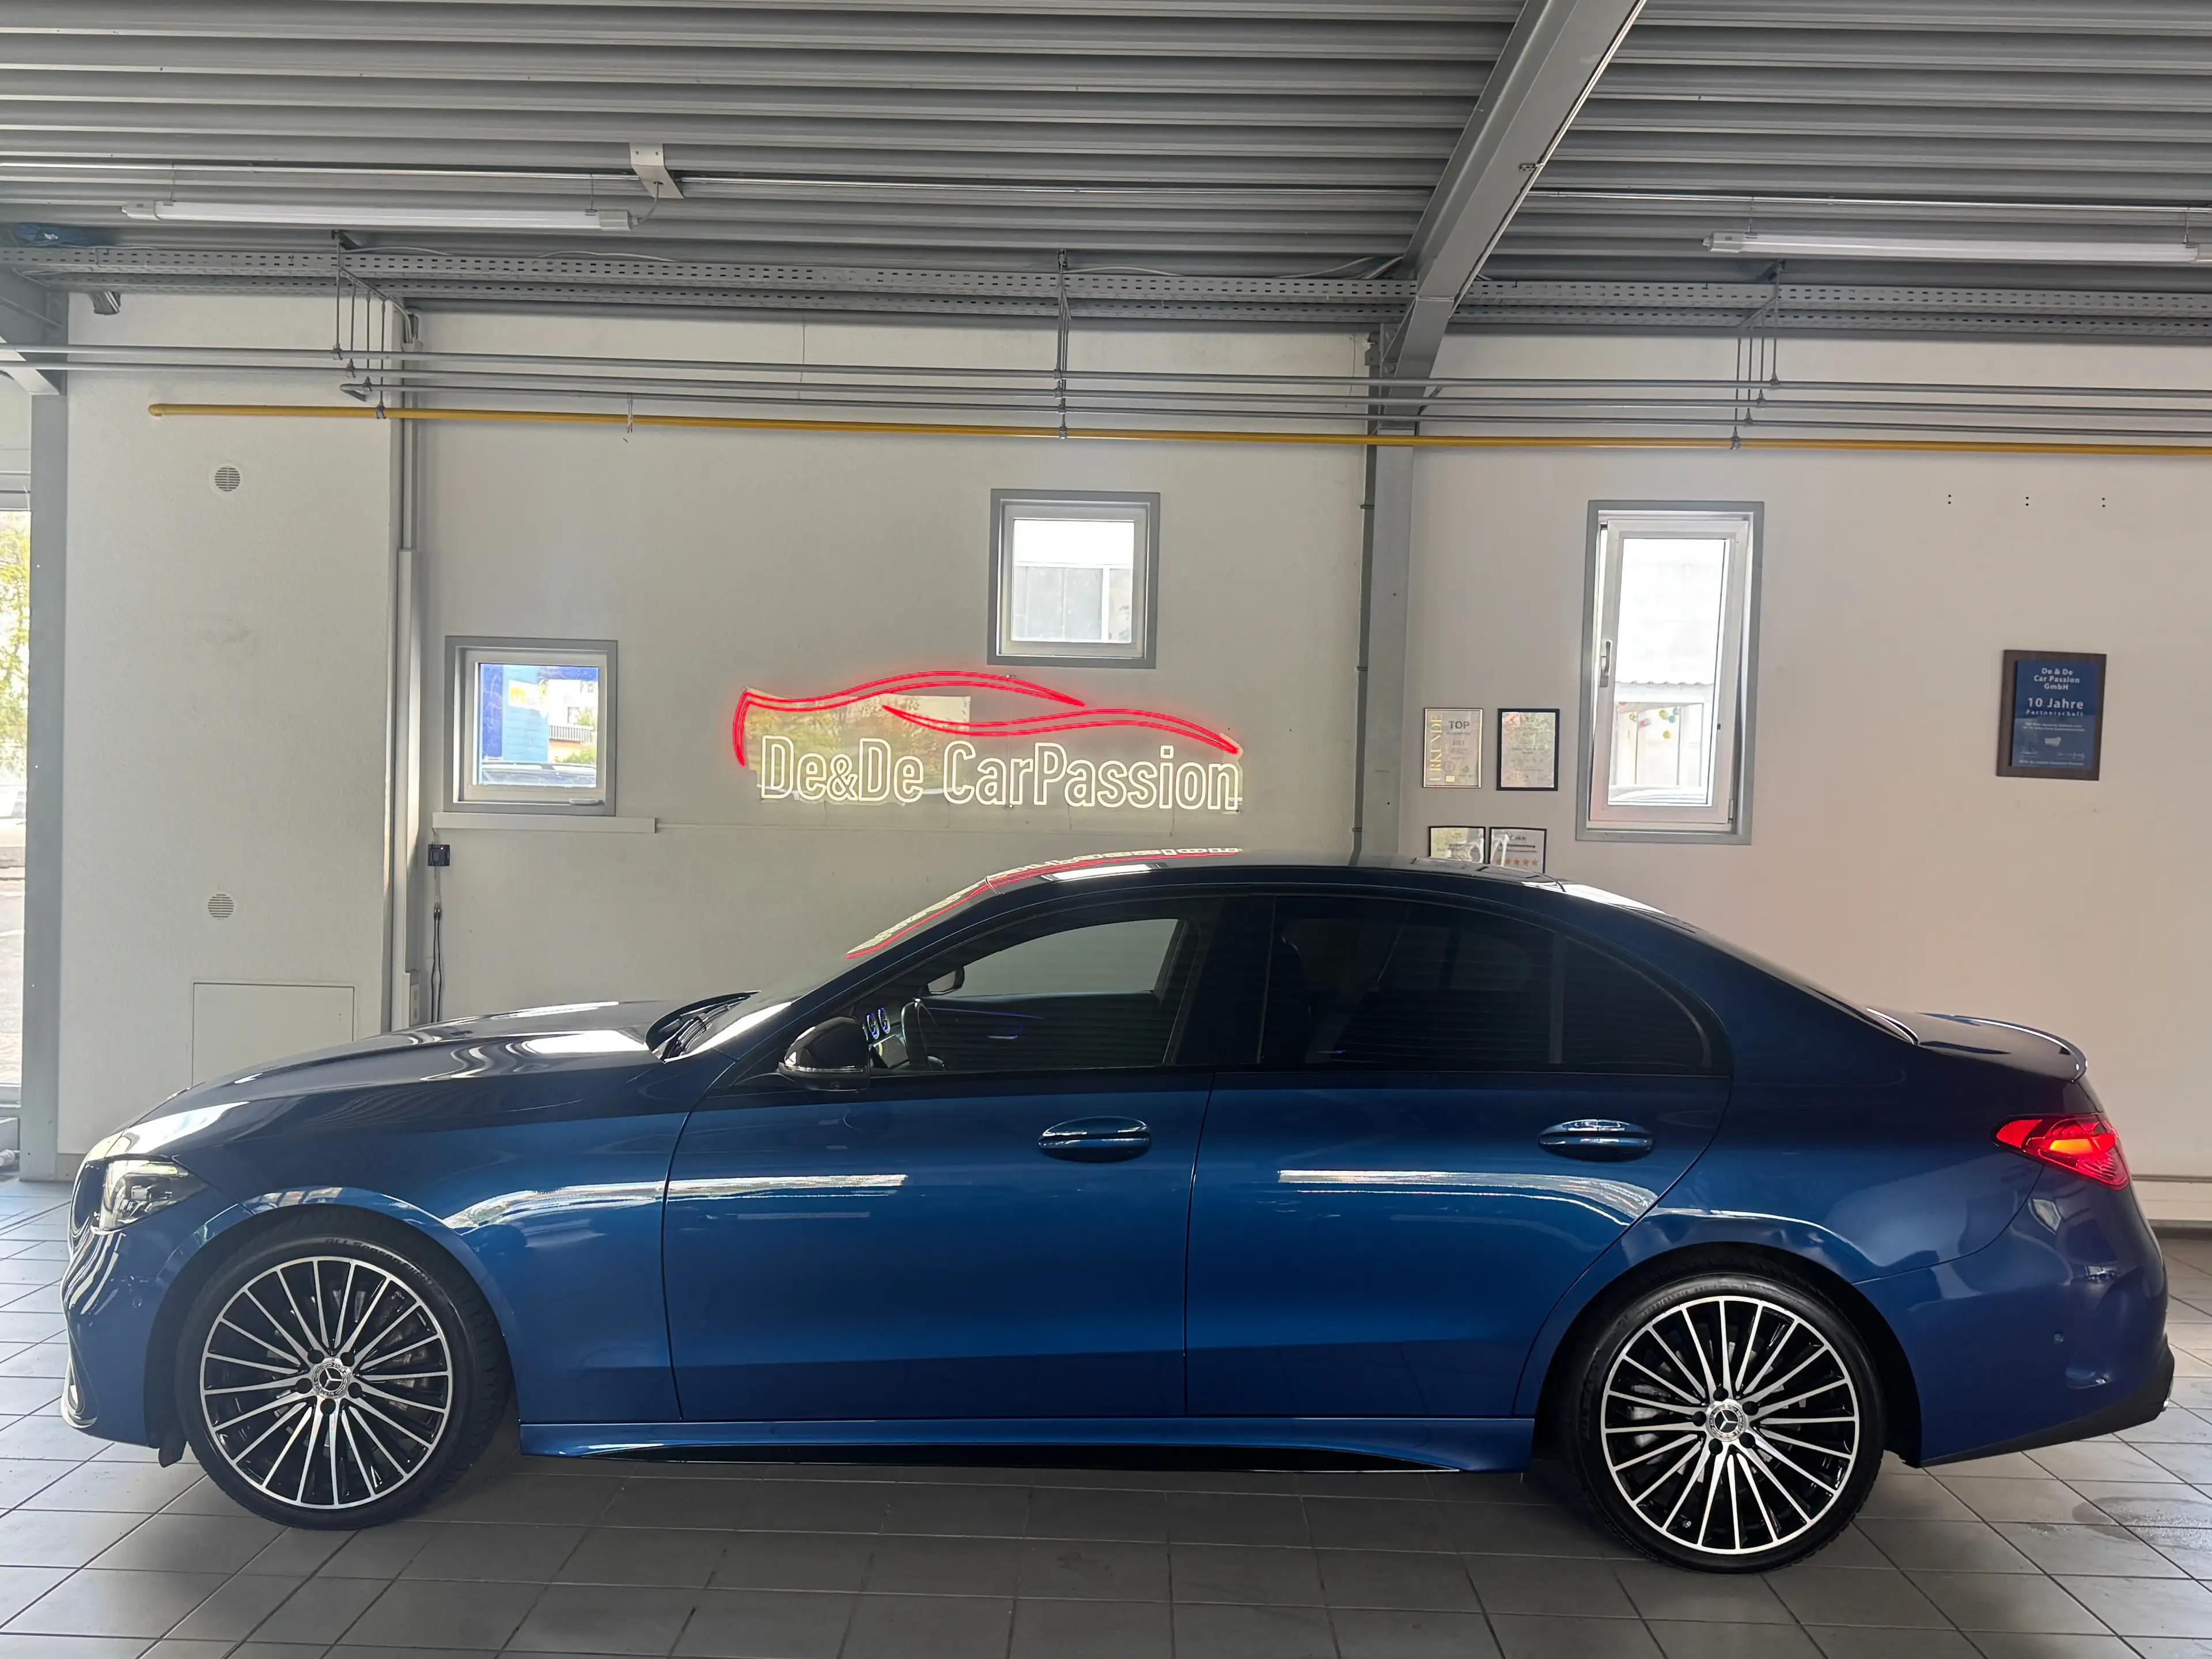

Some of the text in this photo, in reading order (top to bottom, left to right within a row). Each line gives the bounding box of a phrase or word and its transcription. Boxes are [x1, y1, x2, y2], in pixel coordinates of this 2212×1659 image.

[2049, 676, 2080, 684] Passion
[2028, 697, 2084, 710] 10 Jahre
[1448, 720, 1470, 729] TOP
[761, 735, 1239, 810] De&De CarPassion
